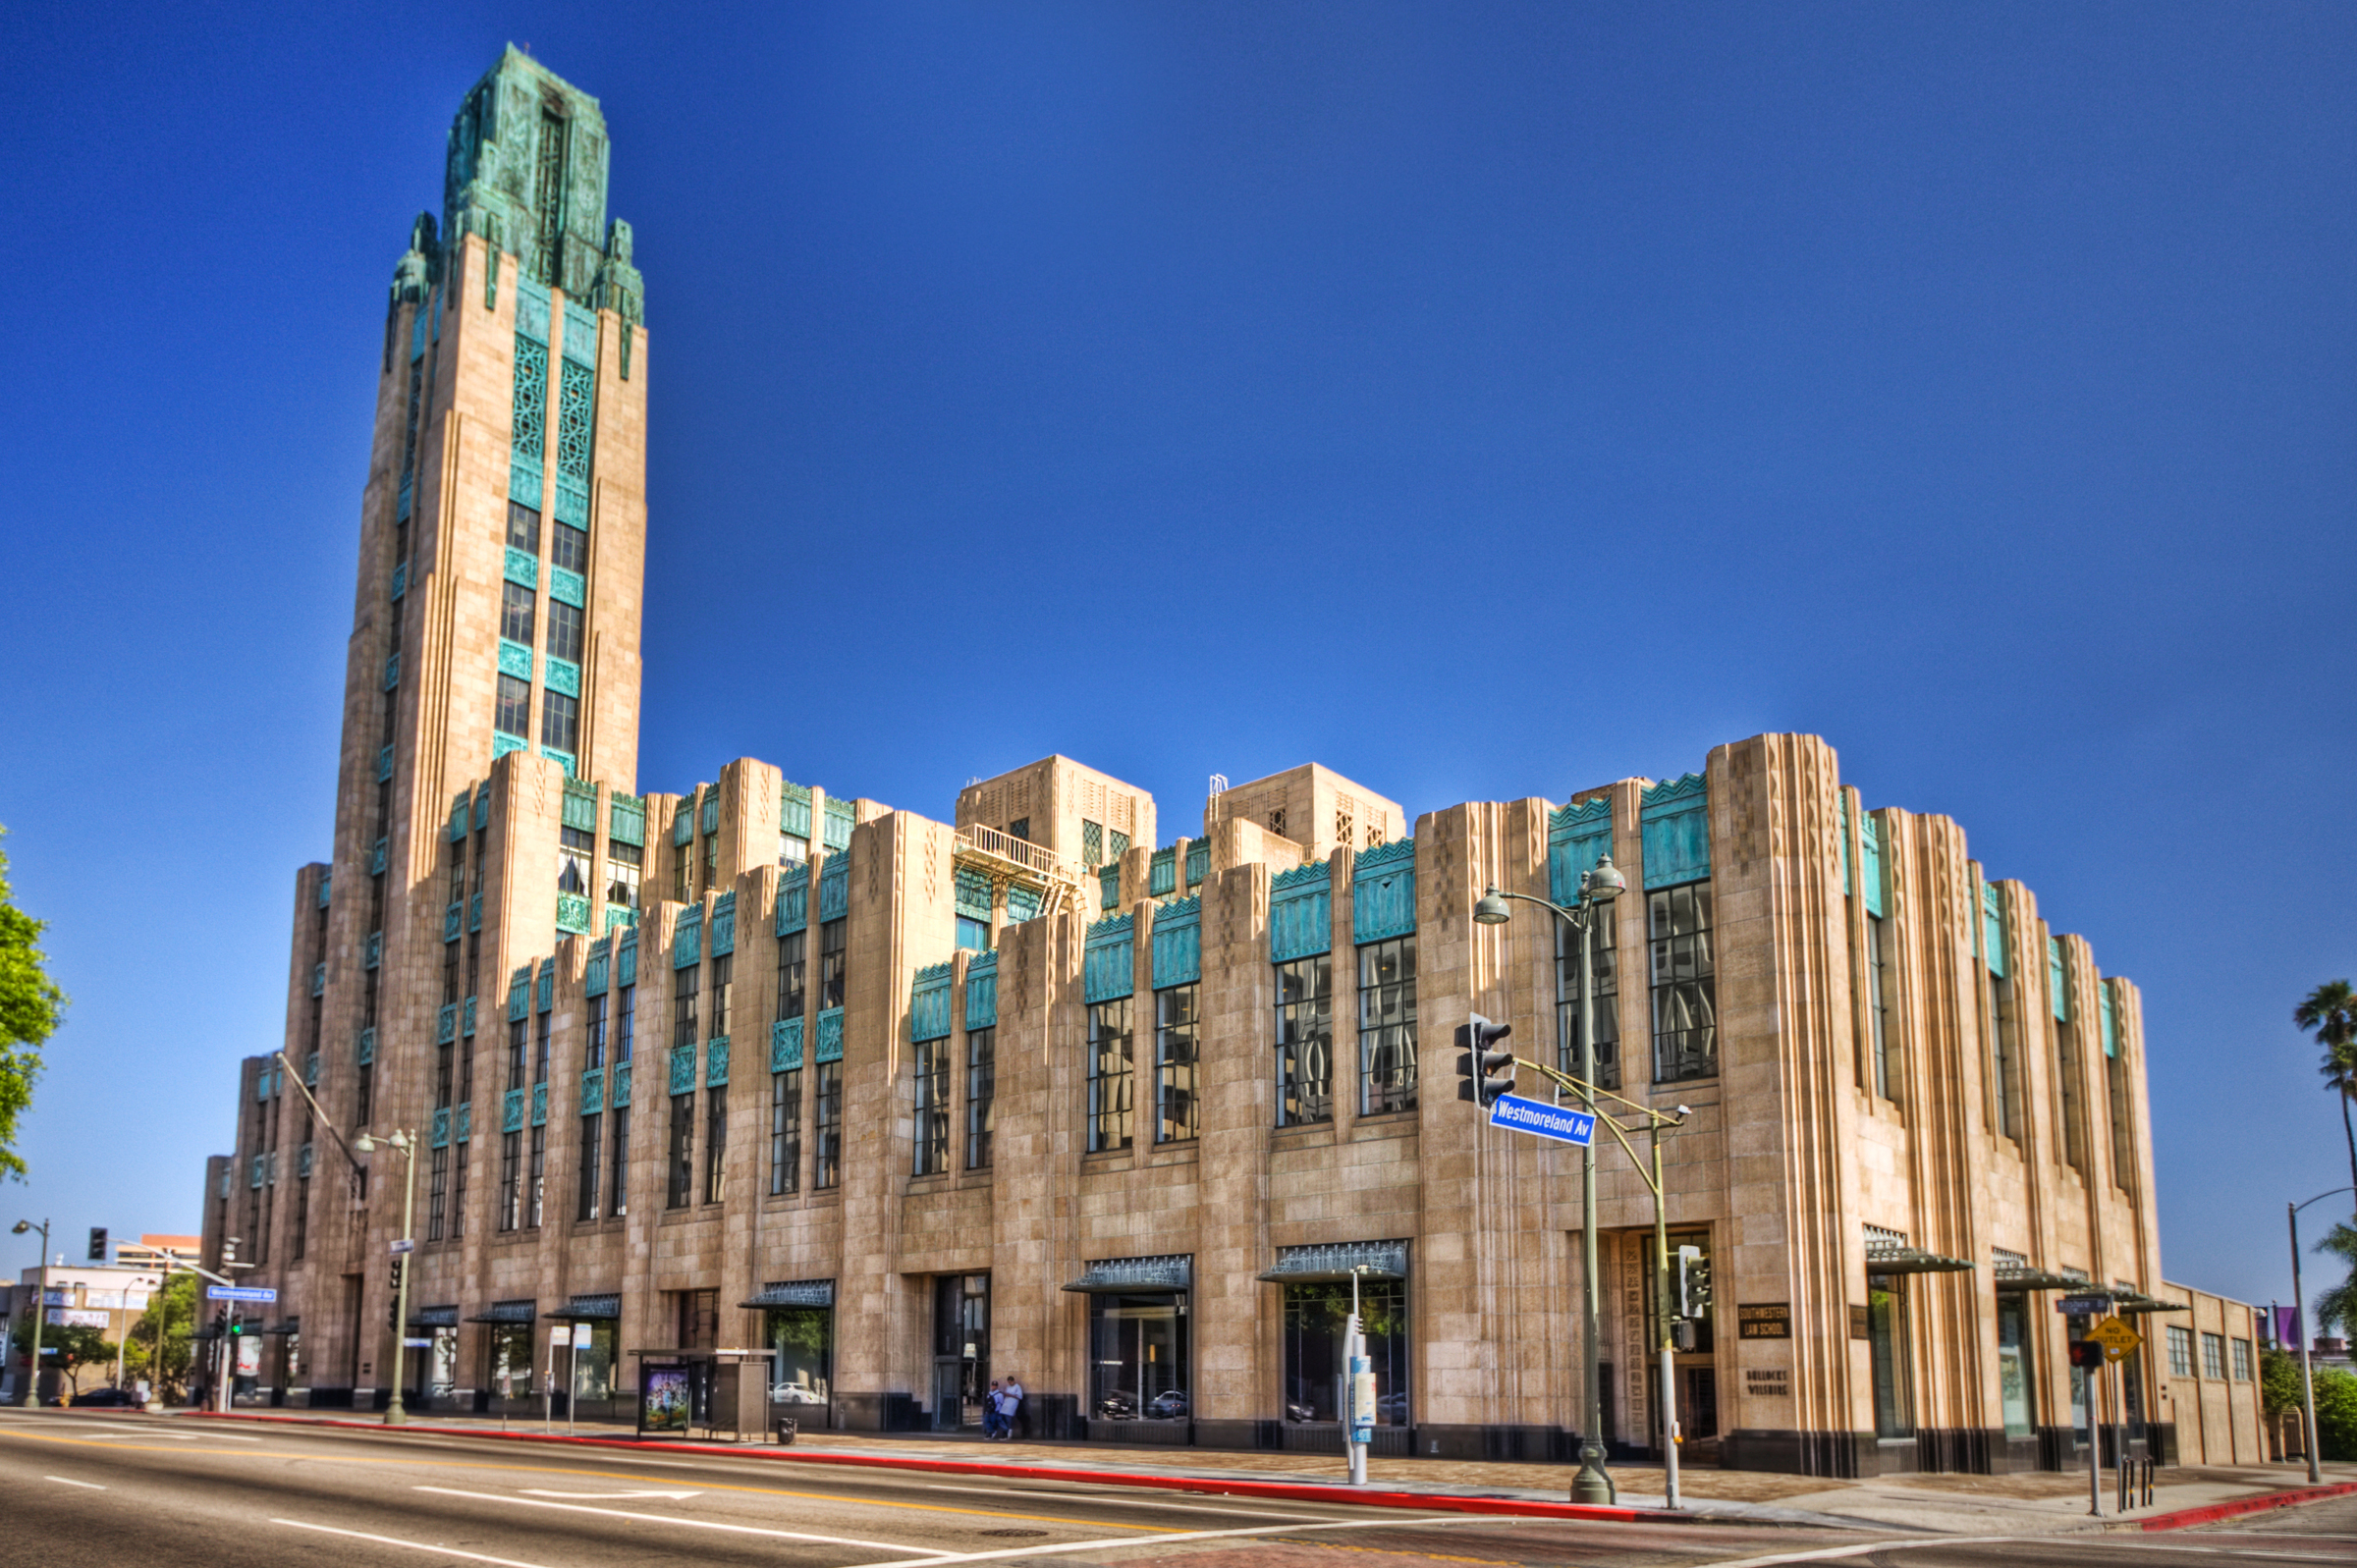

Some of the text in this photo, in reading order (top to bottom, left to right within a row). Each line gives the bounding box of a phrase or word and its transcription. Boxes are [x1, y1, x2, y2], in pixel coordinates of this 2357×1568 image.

[1498, 1100, 1590, 1137] Westmoreland Av
[1739, 1307, 1788, 1320] SOUTHWESTERN
[1744, 1323, 1784, 1335] LAW SCHOOL
